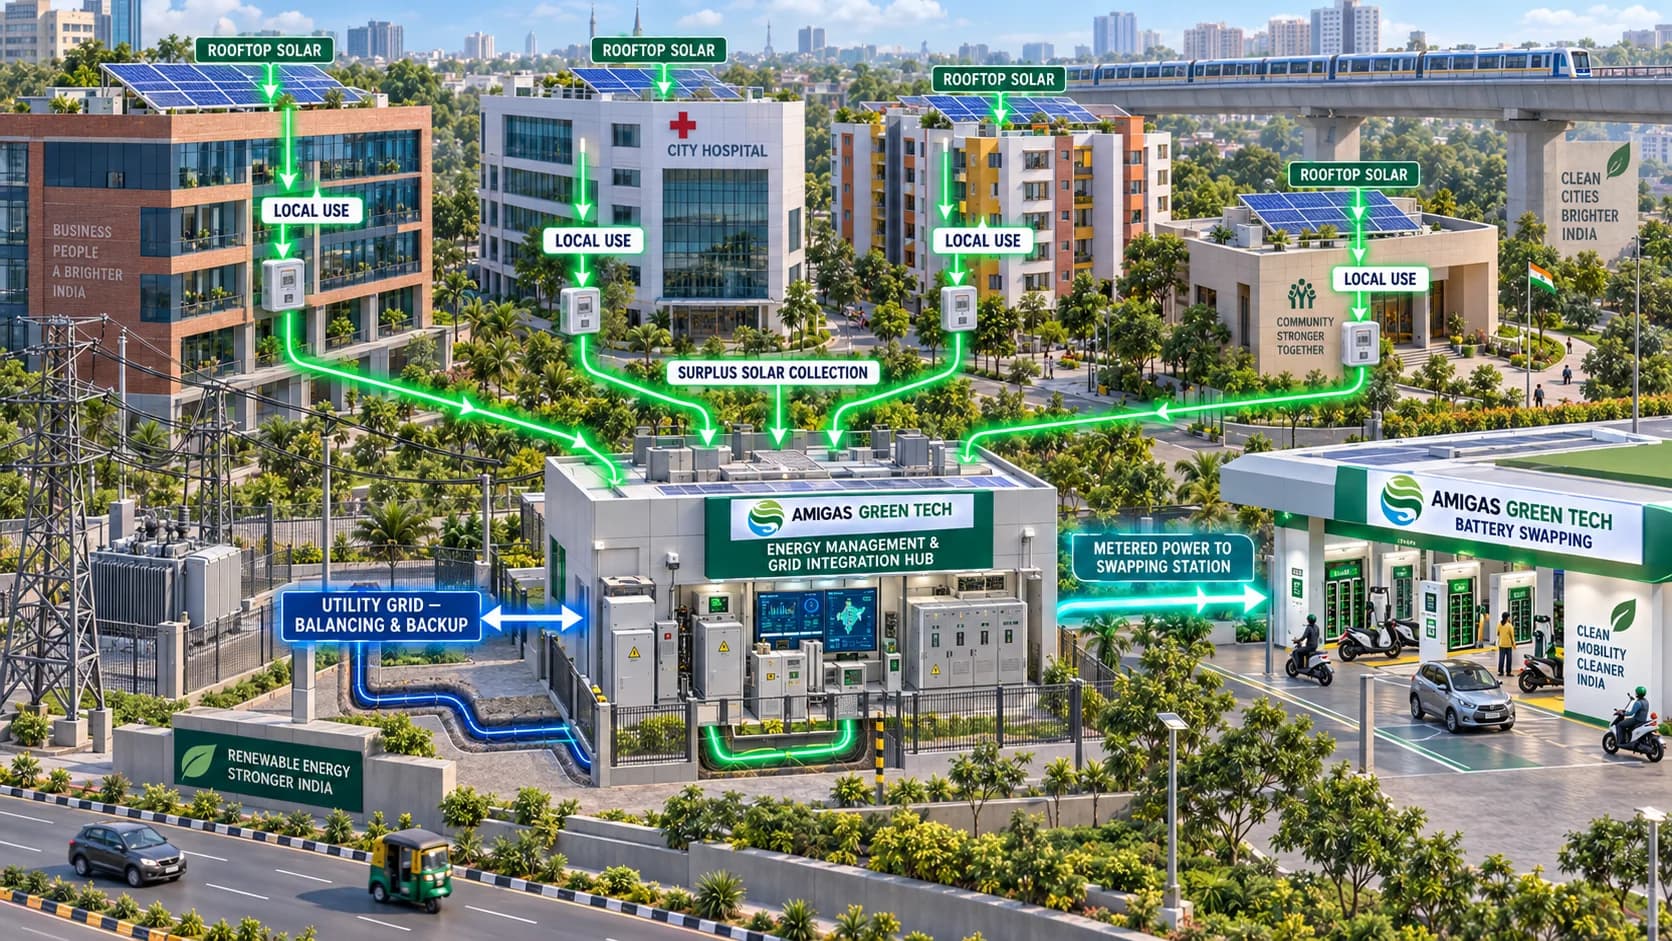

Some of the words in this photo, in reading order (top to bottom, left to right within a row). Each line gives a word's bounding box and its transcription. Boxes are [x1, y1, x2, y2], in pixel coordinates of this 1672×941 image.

[667, 144, 698, 157] CITY
[702, 144, 768, 157] HOSPITAL
[1561, 171, 1601, 185] CLEAN
[1561, 190, 1599, 203] CITIES
[1562, 209, 1619, 222] BRIGHTER
[53, 224, 112, 238] BUSINESS
[1562, 227, 1597, 241] INDIA
[53, 244, 98, 259] PEOPLE
[52, 265, 62, 279] A
[65, 266, 123, 281] BRIGHTER
[53, 284, 86, 299] INDIA
[1277, 317, 1334, 327] COMMUNITY
[1277, 331, 1325, 341] STRONGER
[1277, 345, 1324, 355] TOGETHER
[792, 506, 852, 522] AMIGAS
[859, 504, 908, 519] GREEN
[913, 502, 952, 517] TECH
[1431, 490, 1501, 515] AMIGAS
[1506, 500, 1562, 524] GREEN
[1568, 508, 1612, 531] TECH
[1456, 517, 1515, 538] BATTERY
[1519, 526, 1592, 549] SWAPPING
[767, 541, 821, 556] ENERGY
[826, 537, 926, 553] MANAGEMENT
[930, 536, 939, 549] &
[768, 558, 801, 571] GRID
[807, 554, 900, 570] INTEGRATION
[905, 552, 934, 566] HUB
[1577, 624, 1610, 641] CLEAN
[1577, 641, 1627, 661] MOBILITY
[1577, 657, 1624, 678] CLEANER
[1577, 673, 1605, 690] INDIA
[228, 748, 300, 771] RENEWABLE
[303, 759, 350, 778] ENERGY
[228, 767, 294, 789] STRONGER
[298, 777, 333, 795] INDIA
